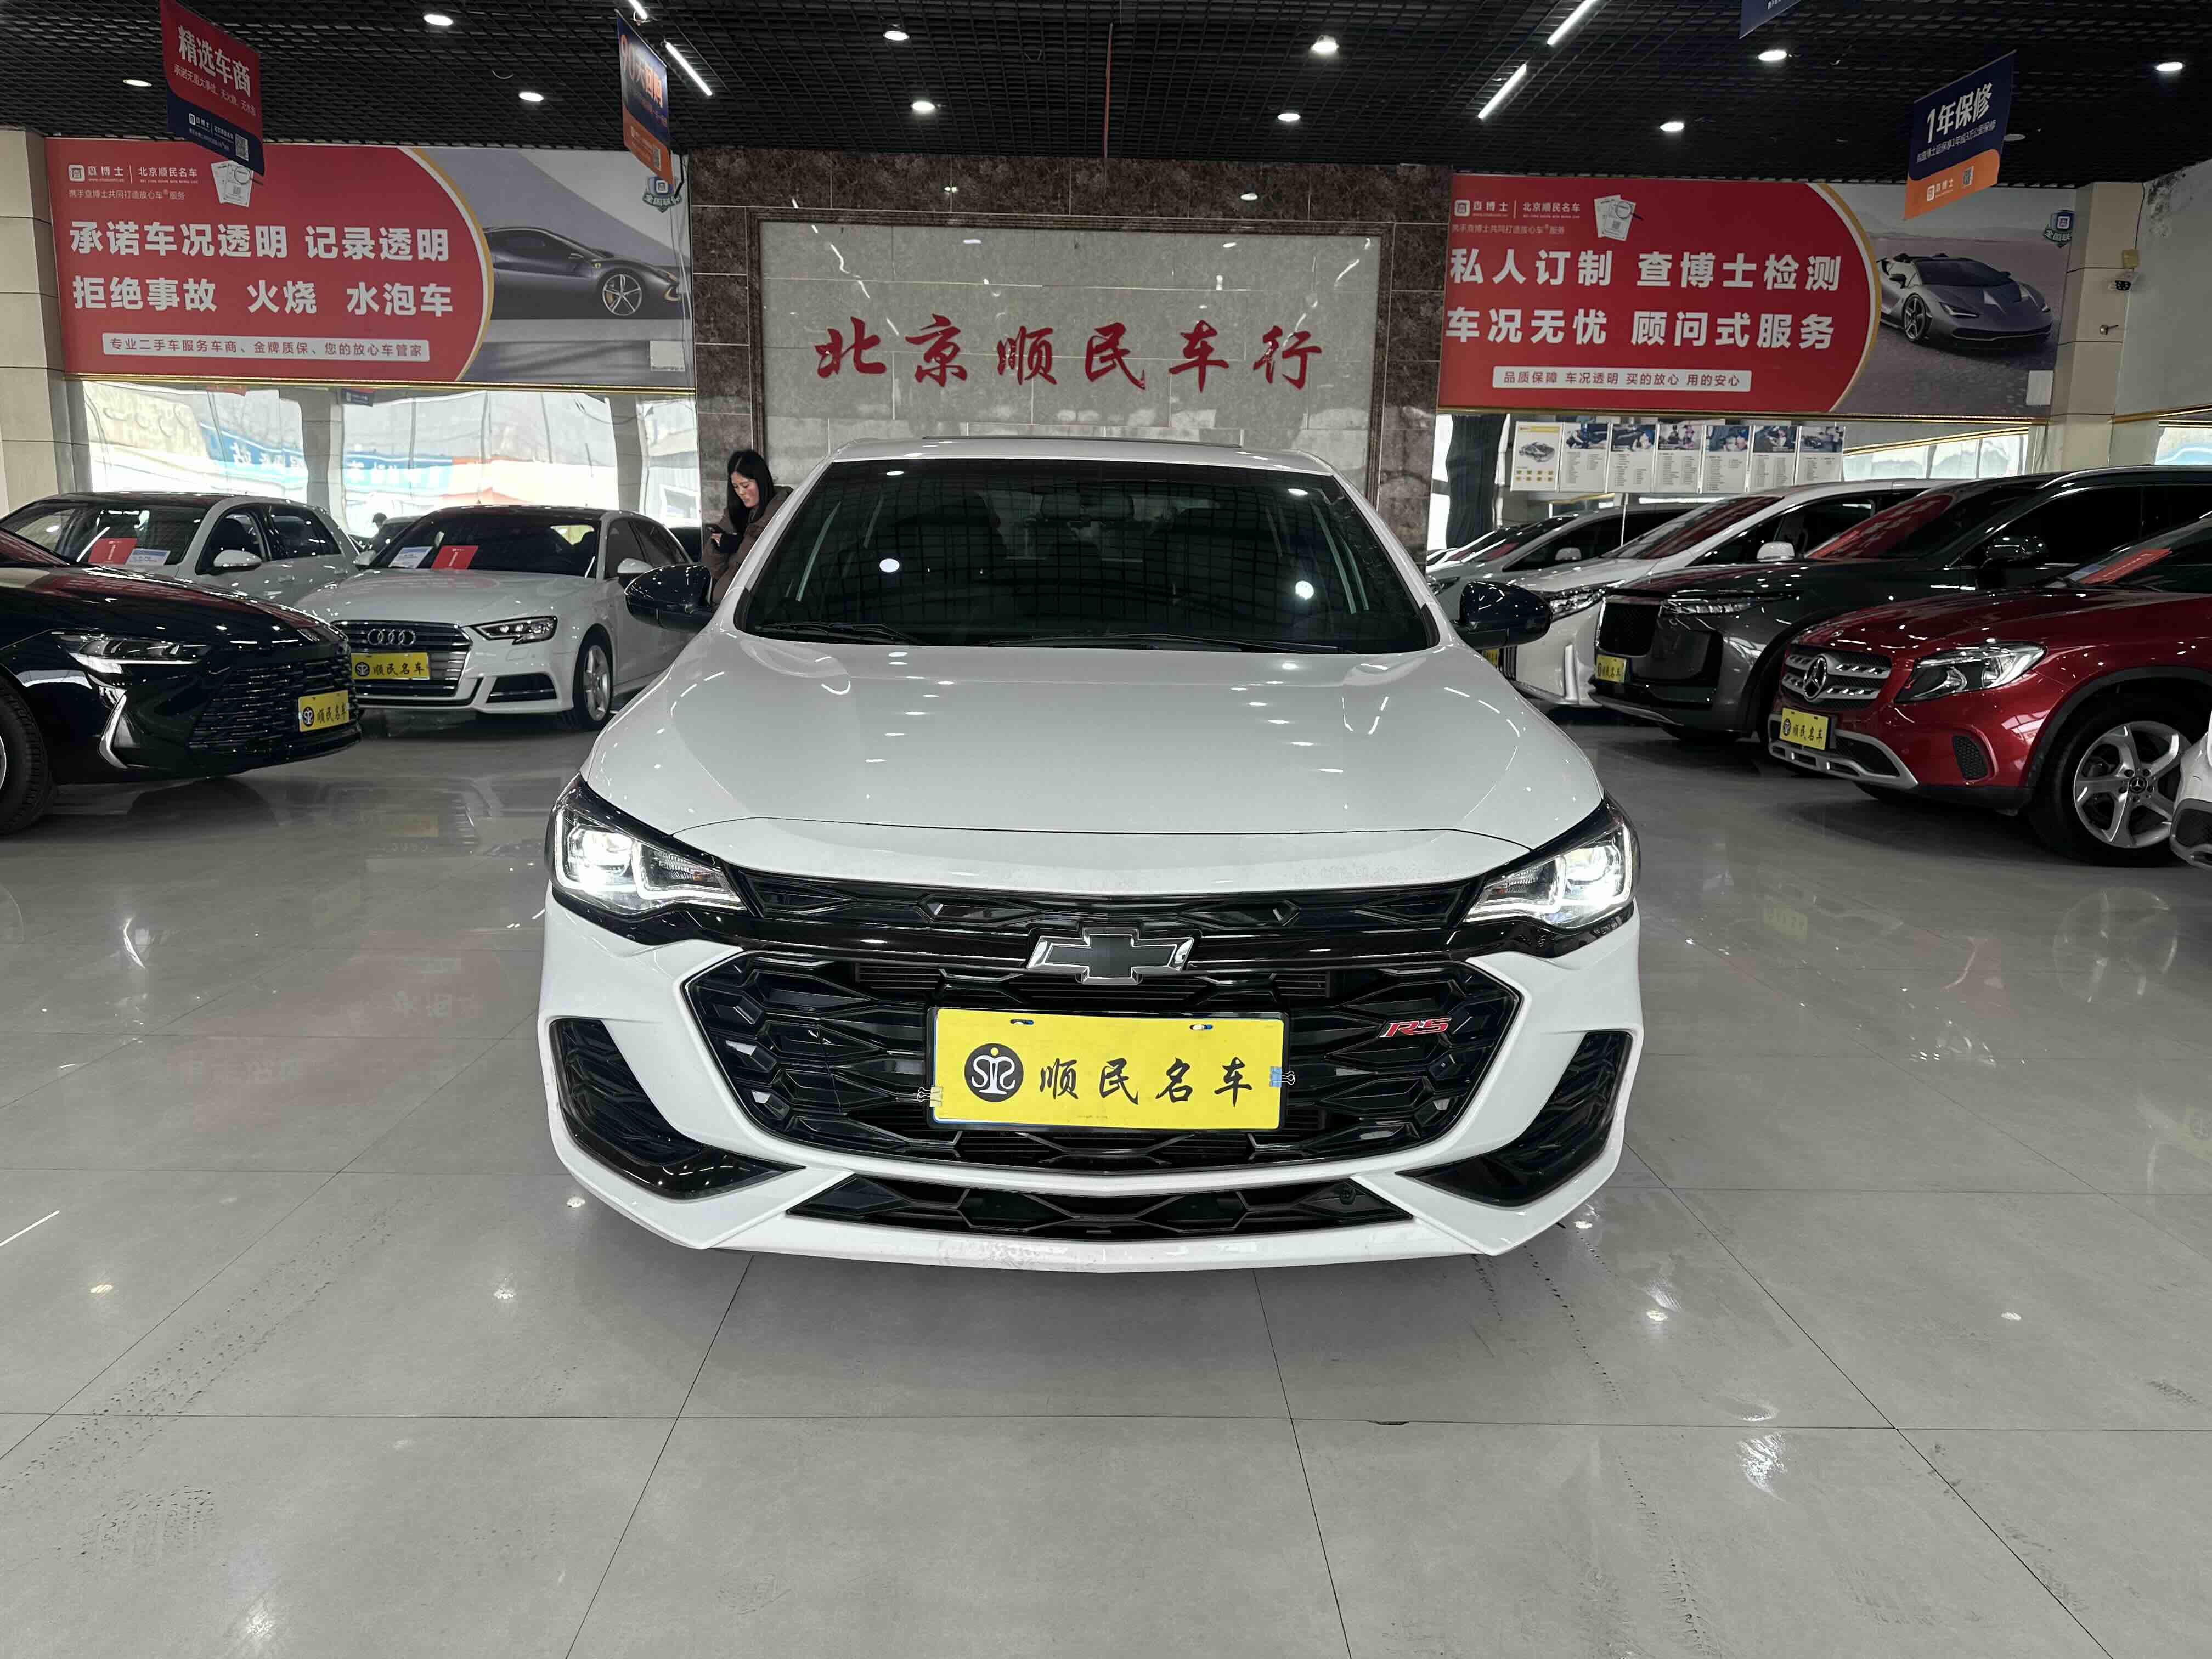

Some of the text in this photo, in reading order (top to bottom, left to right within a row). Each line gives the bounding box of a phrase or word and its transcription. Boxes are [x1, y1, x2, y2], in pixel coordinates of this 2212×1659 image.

[178, 25, 251, 97] 精选车商
[1927, 82, 1993, 143] 1年保修
[138, 167, 198, 178] 北京顺民名车
[1523, 202, 1581, 213] 北京顺民名车
[70, 221, 449, 262] 承诺车况透明 记录透明
[1450, 248, 1841, 291] 私人订制 查博士检测
[73, 275, 453, 317] 拒绝事故 火烧 水泡车
[1446, 307, 1835, 349] 车况无忧 顾问式服务
[816, 313, 1322, 393] 北京顺民车行
[1504, 371, 1740, 387] 品质保障 车况透明 买的放心 用的安心
[373, 662, 424, 676] 顺民名车
[1379, 1017, 1452, 1038] RS
[1040, 1057, 1252, 1107] 顺民名车
